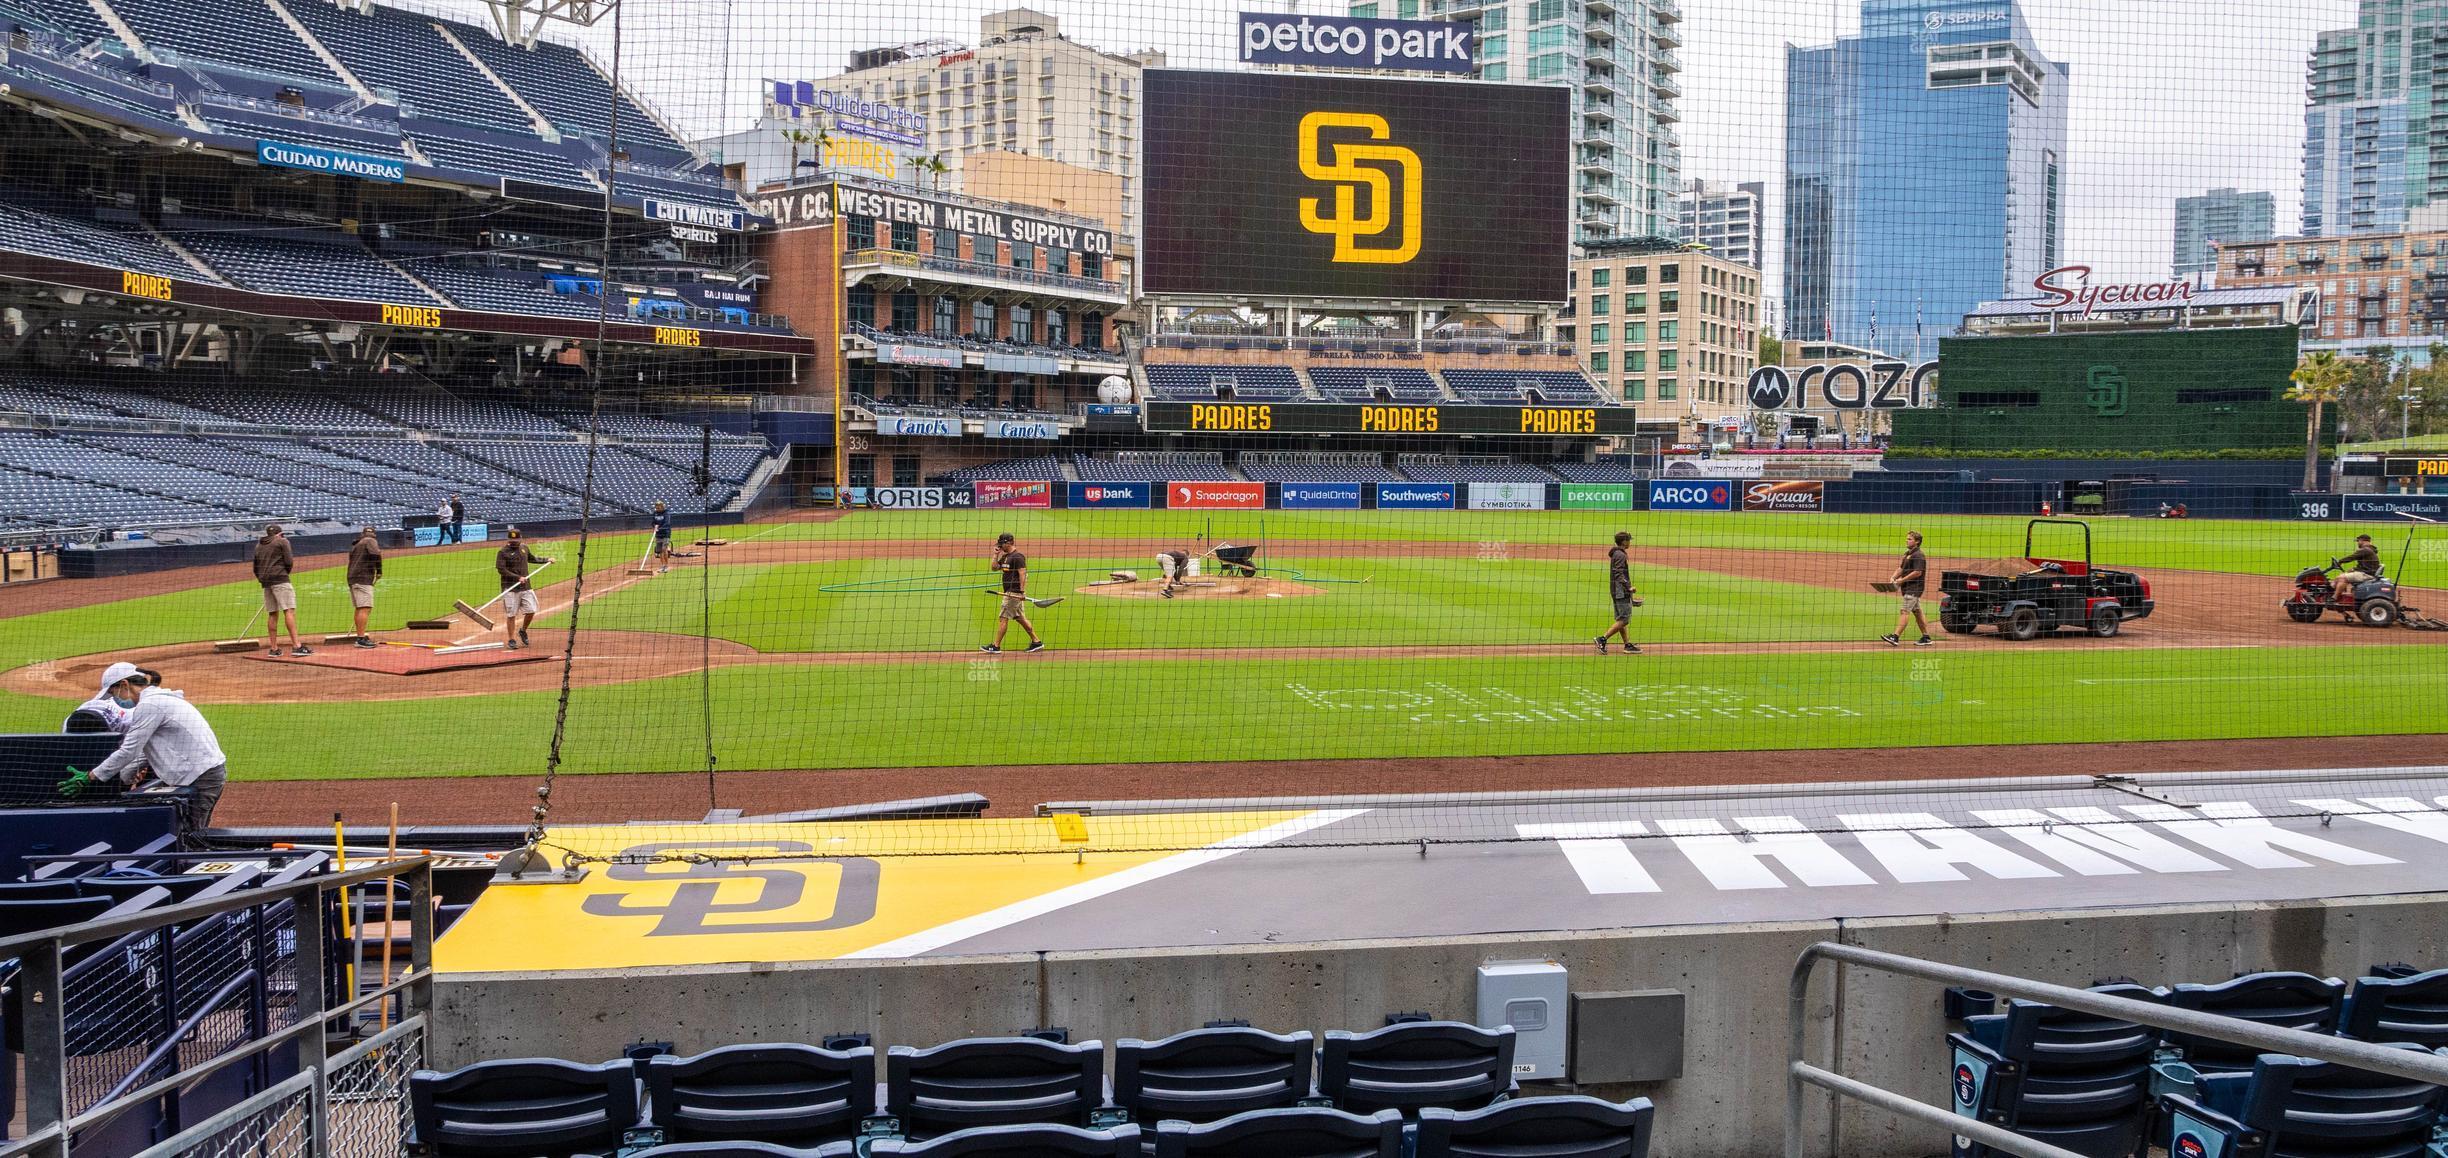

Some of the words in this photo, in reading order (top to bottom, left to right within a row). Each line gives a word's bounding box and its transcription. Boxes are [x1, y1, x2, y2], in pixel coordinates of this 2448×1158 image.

[1947, 11, 2006, 25] SEMPRA
[1244, 17, 1366, 60] petco
[1374, 27, 1469, 65] park
[818, 89, 924, 131] QuidelOrtho
[263, 146, 330, 169] CIUDAD
[333, 156, 402, 179] MADERAS
[824, 136, 895, 180] PADRES
[1299, 111, 1422, 263] SD
[656, 200, 733, 229] CUTWATER
[801, 191, 834, 221] CO.
[837, 187, 935, 227] WESTERN
[945, 206, 1007, 239] METAL
[1011, 219, 1077, 249] SUPPLY
[1084, 231, 1111, 255] CO.
[671, 225, 718, 243] SPIRITS
[123, 270, 172, 300] PADRES
[2030, 265, 2197, 318] Sycuan
[382, 303, 441, 327] PADRES
[655, 327, 700, 347] PADRES
[1796, 361, 1938, 410] razr
[896, 418, 949, 436] Canel's
[1192, 403, 1271, 431] PADRES
[1361, 406, 1438, 431] PADRES
[1521, 408, 1596, 433] PADRES
[1000, 421, 1047, 439] Canel's
[849, 435, 869, 450] 336
[878, 489, 940, 507] ORIS
[948, 491, 970, 505] 342
[1087, 489, 1101, 499] us
[1103, 487, 1132, 499] bank
[1196, 490, 1258, 502] Snapdragon
[1300, 490, 1357, 501] QuidelOrtho
[1382, 490, 1442, 501] Southwest
[1652, 487, 1708, 503] ARCO
[1748, 483, 1815, 509] Sycuan
[2302, 503, 2329, 518] 396
[2352, 502, 2367, 512] UC
[2367, 502, 2384, 512] San
[2385, 503, 2410, 513] Diego
[2411, 503, 2441, 513] Health
[1514, 801, 2407, 895] THANK
